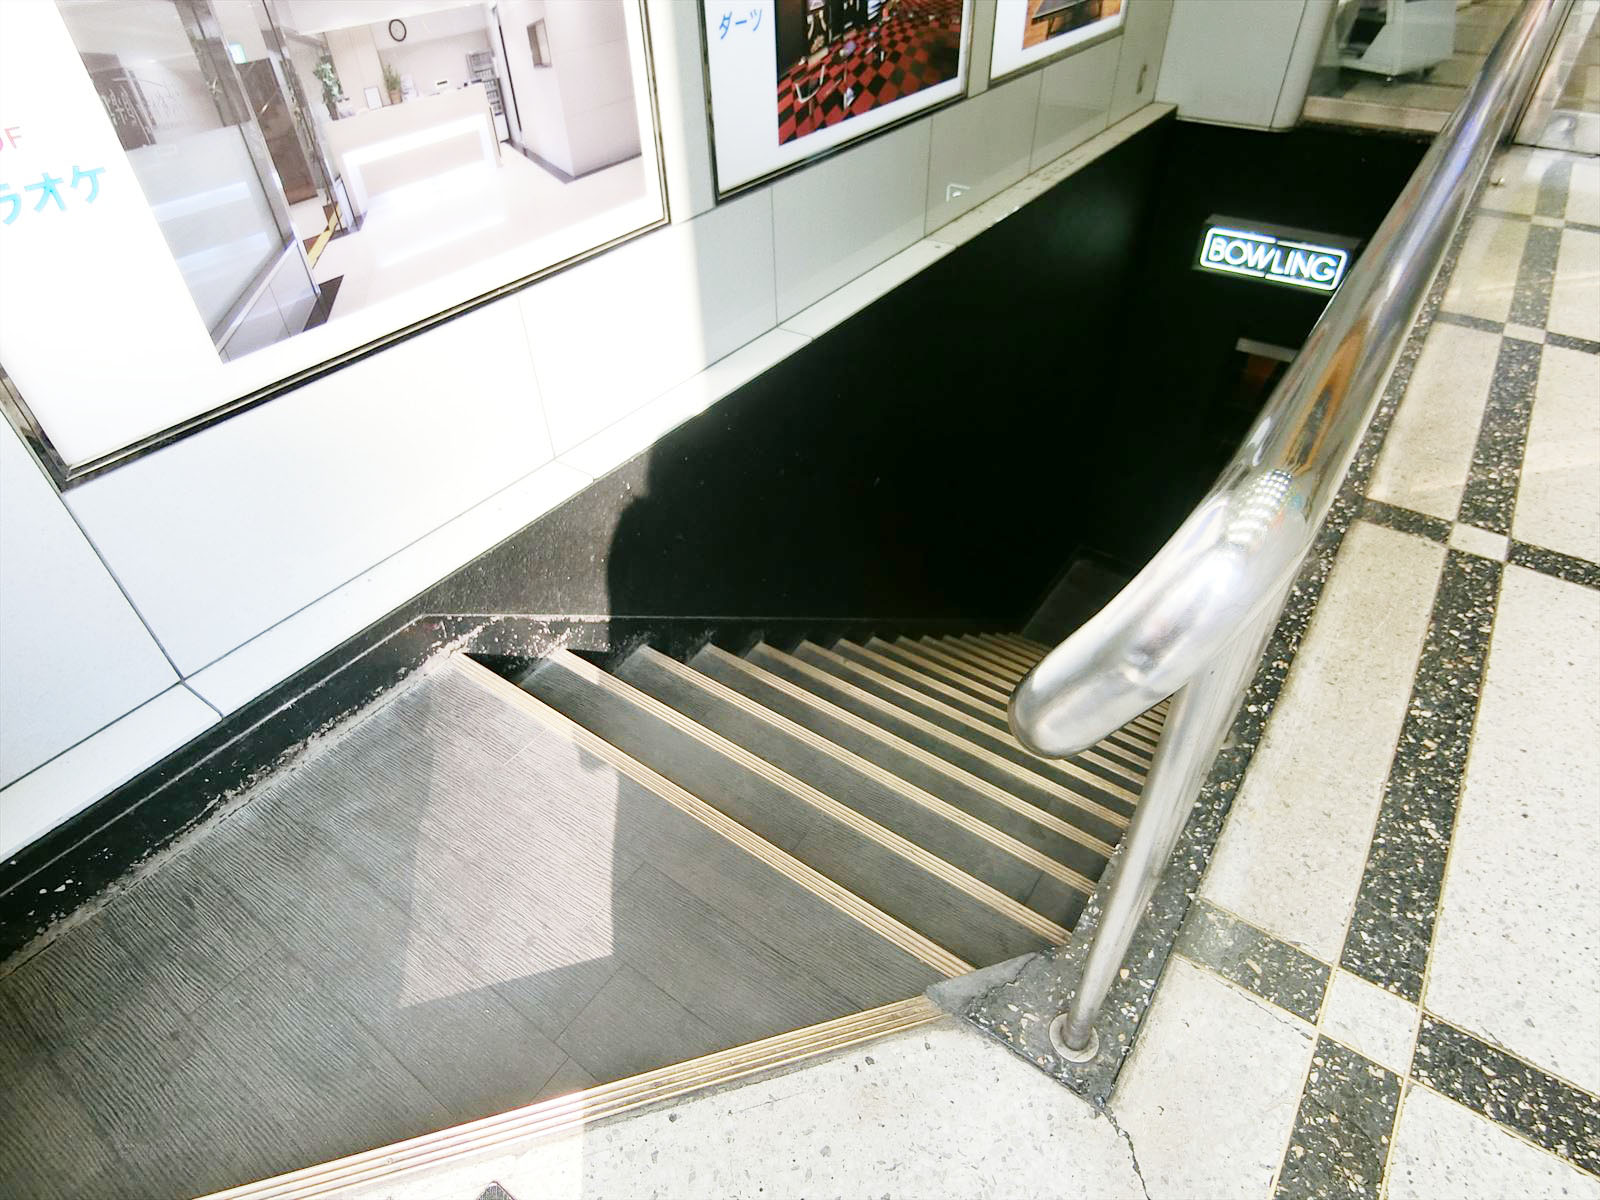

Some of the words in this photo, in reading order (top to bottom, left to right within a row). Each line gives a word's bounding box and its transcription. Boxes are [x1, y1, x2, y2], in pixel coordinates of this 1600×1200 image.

[719, 9, 763, 40] ダーツ
[0, 126, 22, 150] F
[1207, 236, 1338, 283] BOWLING
